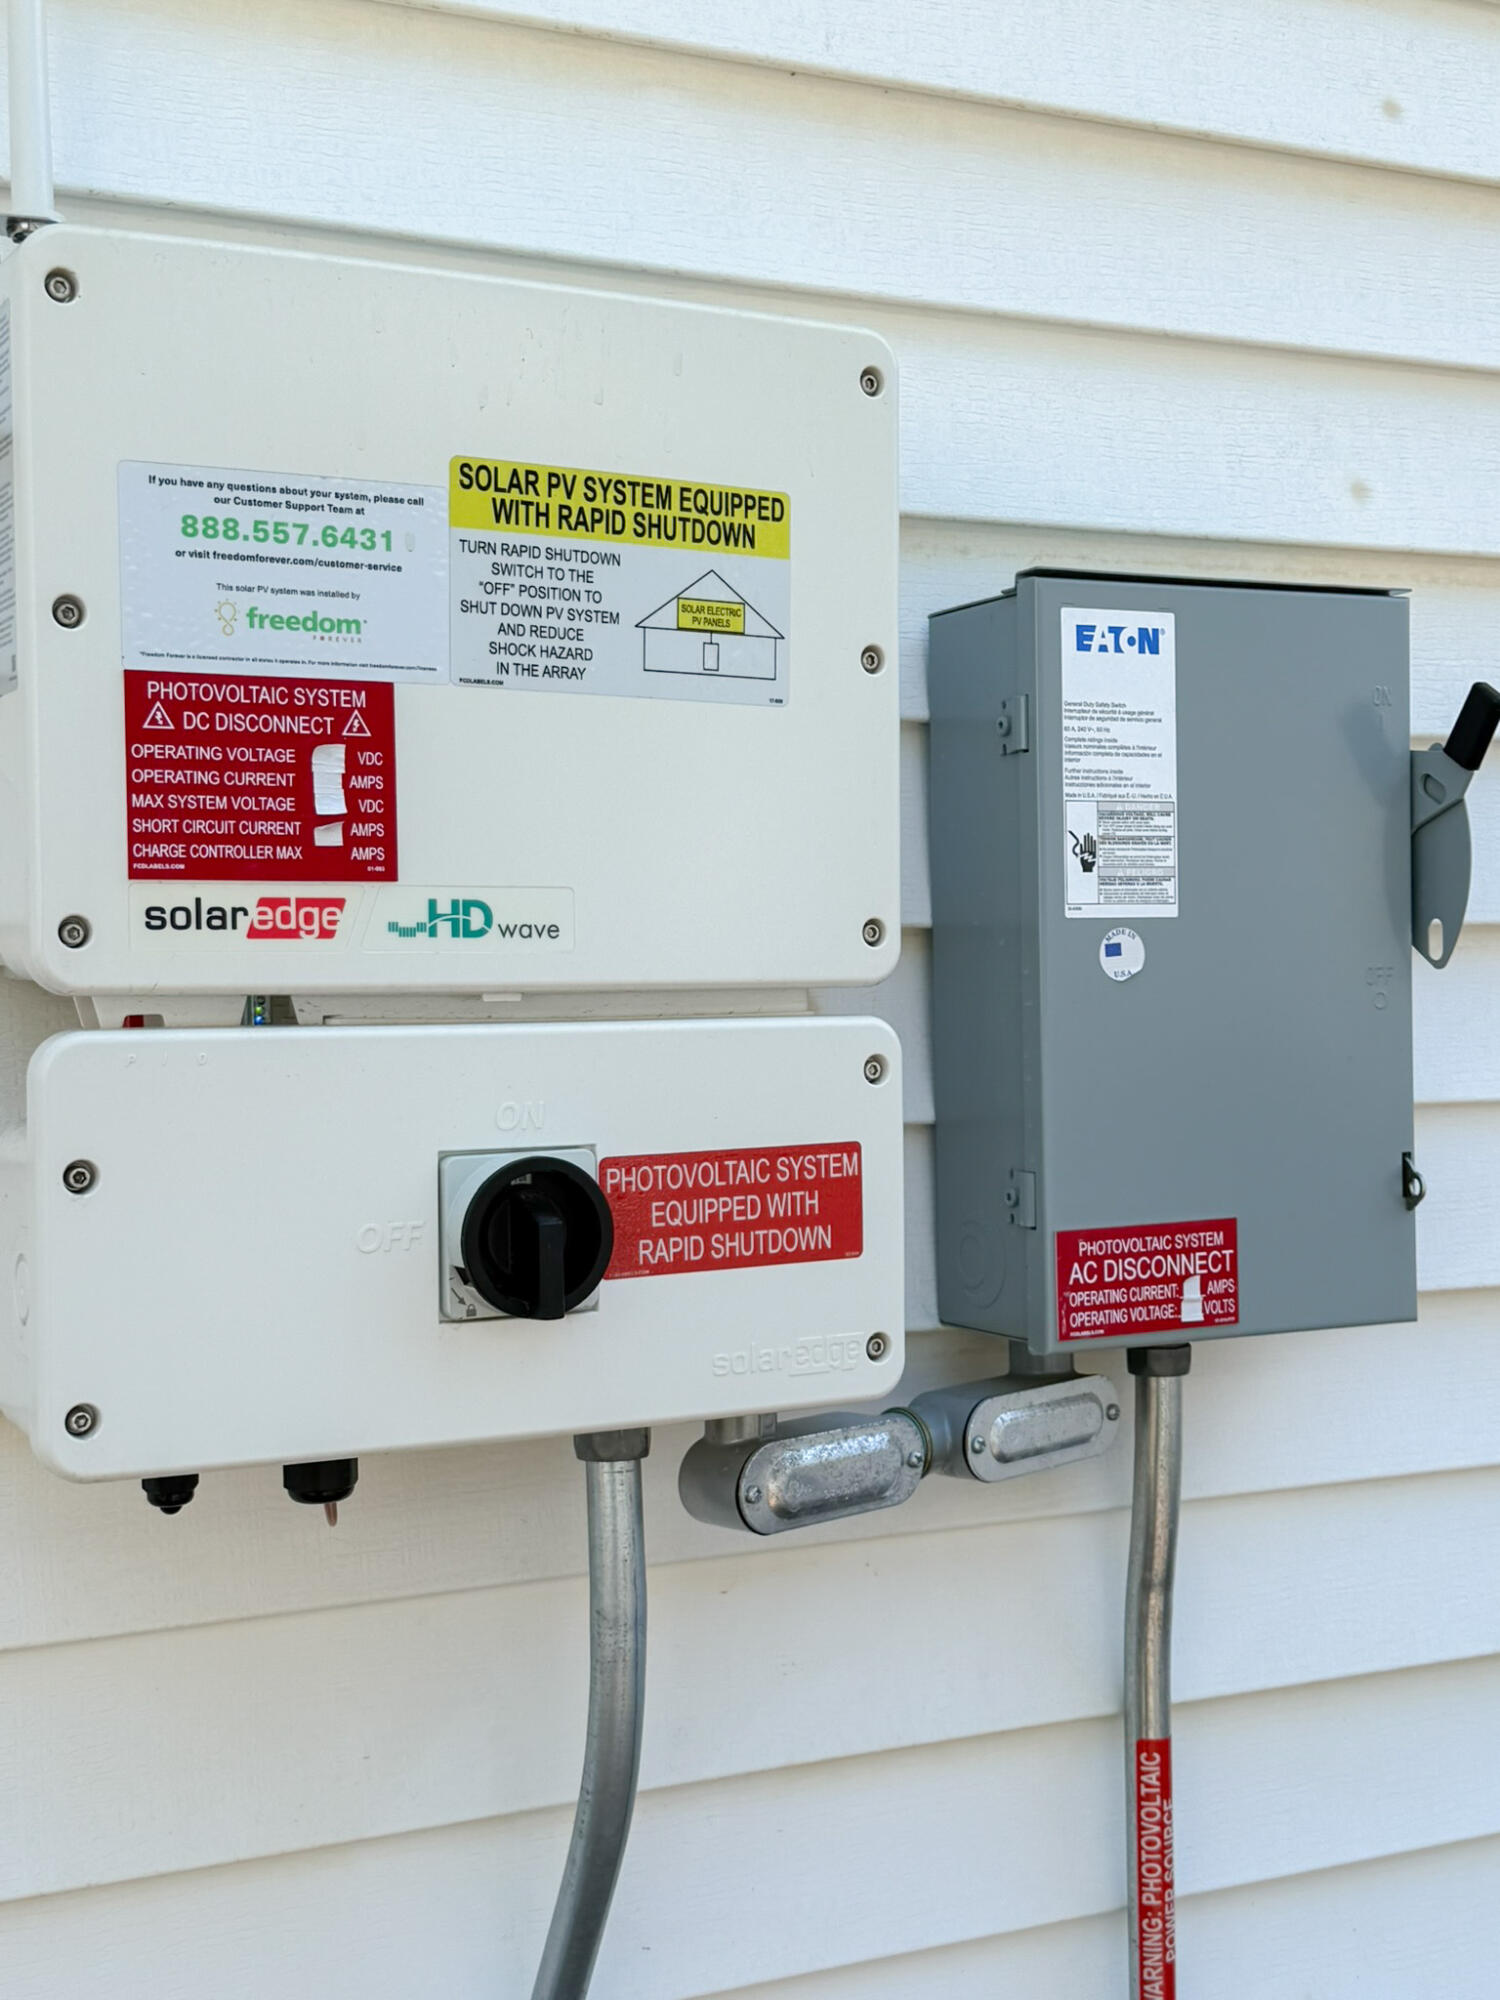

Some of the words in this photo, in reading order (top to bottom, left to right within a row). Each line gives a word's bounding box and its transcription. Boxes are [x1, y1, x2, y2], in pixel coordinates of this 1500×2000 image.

[148, 475, 156, 484] If
[158, 476, 177, 486] you
[180, 477, 204, 488] have
[206, 480, 225, 491] any
[227, 481, 277, 494] questions
[279, 486, 308, 497] about
[310, 489, 332, 499] your
[335, 491, 371, 503] system,
[374, 494, 405, 505] please
[407, 497, 424, 506] call
[459, 463, 540, 497] SOLAR
[548, 472, 577, 500] PV
[583, 476, 671, 510] SYSTEM
[679, 487, 784, 522] EQUIPPED
[213, 496, 231, 505] our
[233, 496, 282, 509] Customer
[285, 500, 325, 513] Support
[327, 503, 353, 515] Team
[355, 506, 365, 516] at
[181, 514, 392, 552] 888.557.6431
[492, 497, 549, 528] WITH
[558, 504, 626, 535] RAPID
[633, 512, 755, 549] SHUTDOWN
[175, 550, 187, 558] or
[188, 550, 211, 560] visit
[212, 550, 403, 573] freedomforever.com/customer-service
[459, 539, 497, 556] TURN
[501, 543, 541, 559] RAPID
[545, 547, 621, 566] SHUTDOWN
[491, 562, 544, 579] SWITCH
[547, 567, 565, 581] TO
[568, 569, 594, 584] THE
[216, 582, 233, 592] This
[235, 585, 255, 593] solar
[257, 586, 269, 594] PV
[270, 587, 298, 596] system
[300, 589, 315, 597] was
[317, 589, 350, 600] installed
[351, 592, 361, 601] by
[519, 584, 581, 601] POSITION
[585, 590, 603, 604] TO
[246, 606, 361, 635] freedom
[460, 599, 497, 615] SHUT
[501, 602, 542, 619] DOWN
[546, 606, 564, 620] PV
[567, 608, 620, 625] SYSTEM
[680, 604, 705, 615] SOLAR
[707, 606, 742, 618] ELECTRIC
[692, 615, 703, 625] PV
[703, 616, 731, 628] PANELS
[497, 622, 526, 637] AND
[530, 625, 584, 642] REDUCE
[1076, 624, 1160, 655] EATON
[489, 641, 536, 658] SHOCK
[540, 645, 593, 661] HAZARD
[496, 662, 509, 676] IN
[513, 663, 539, 678] THE
[542, 665, 587, 681] ARRAY
[147, 681, 289, 705] PHOTOVOLTAIC
[294, 687, 366, 708] SYSTEM
[183, 711, 210, 731] DC
[215, 712, 335, 735] DISCONNECT
[131, 743, 223, 761] OPERATING
[226, 746, 296, 764] VOLTAGE
[357, 751, 384, 766] VDC
[131, 768, 220, 786] OPERATING
[223, 771, 296, 788] CURRENT
[349, 775, 384, 790] AMPS
[131, 793, 164, 809] MAX
[167, 794, 228, 810] SYSTEM
[230, 796, 296, 812] VOLTAGE
[358, 799, 384, 814] VDC
[132, 818, 179, 833] SHORT
[182, 819, 236, 834] CIRCUIT
[239, 820, 302, 836] CURRENT
[350, 822, 385, 837] AMPS
[133, 843, 187, 859] CHARGE
[189, 844, 274, 860] CONTROLLER
[276, 845, 303, 860] MAX
[351, 847, 385, 861] AMPS
[144, 897, 344, 939] solaredge
[428, 898, 494, 939] HD
[498, 922, 560, 939] wave
[1105, 928, 1127, 943] MADE
[1127, 930, 1136, 940] IN
[496, 1100, 545, 1131] ON
[606, 1157, 771, 1194] PHOTOVOLTAIC
[776, 1152, 859, 1183] SYSTEM
[651, 1194, 761, 1228] EQUIPPED
[766, 1190, 819, 1219] WITH
[356, 1219, 425, 1254] OFF
[638, 1235, 705, 1266] RAPID
[710, 1224, 832, 1260] SHUTDOWN
[1078, 1234, 1172, 1257] PHOTOVOLTAIC
[1174, 1231, 1224, 1250] SYSTEM
[1069, 1260, 1098, 1286] AC
[1103, 1249, 1234, 1282] DISCONNECT
[1069, 1287, 1128, 1307] OPERATING
[1207, 1278, 1235, 1295] AMPS
[1069, 1308, 1128, 1328] OPERATING
[1204, 1298, 1236, 1315] VOLTS
[712, 1334, 862, 1377] solaredge
[1140, 1751, 1163, 1906] PHOTOVOLTAIC
